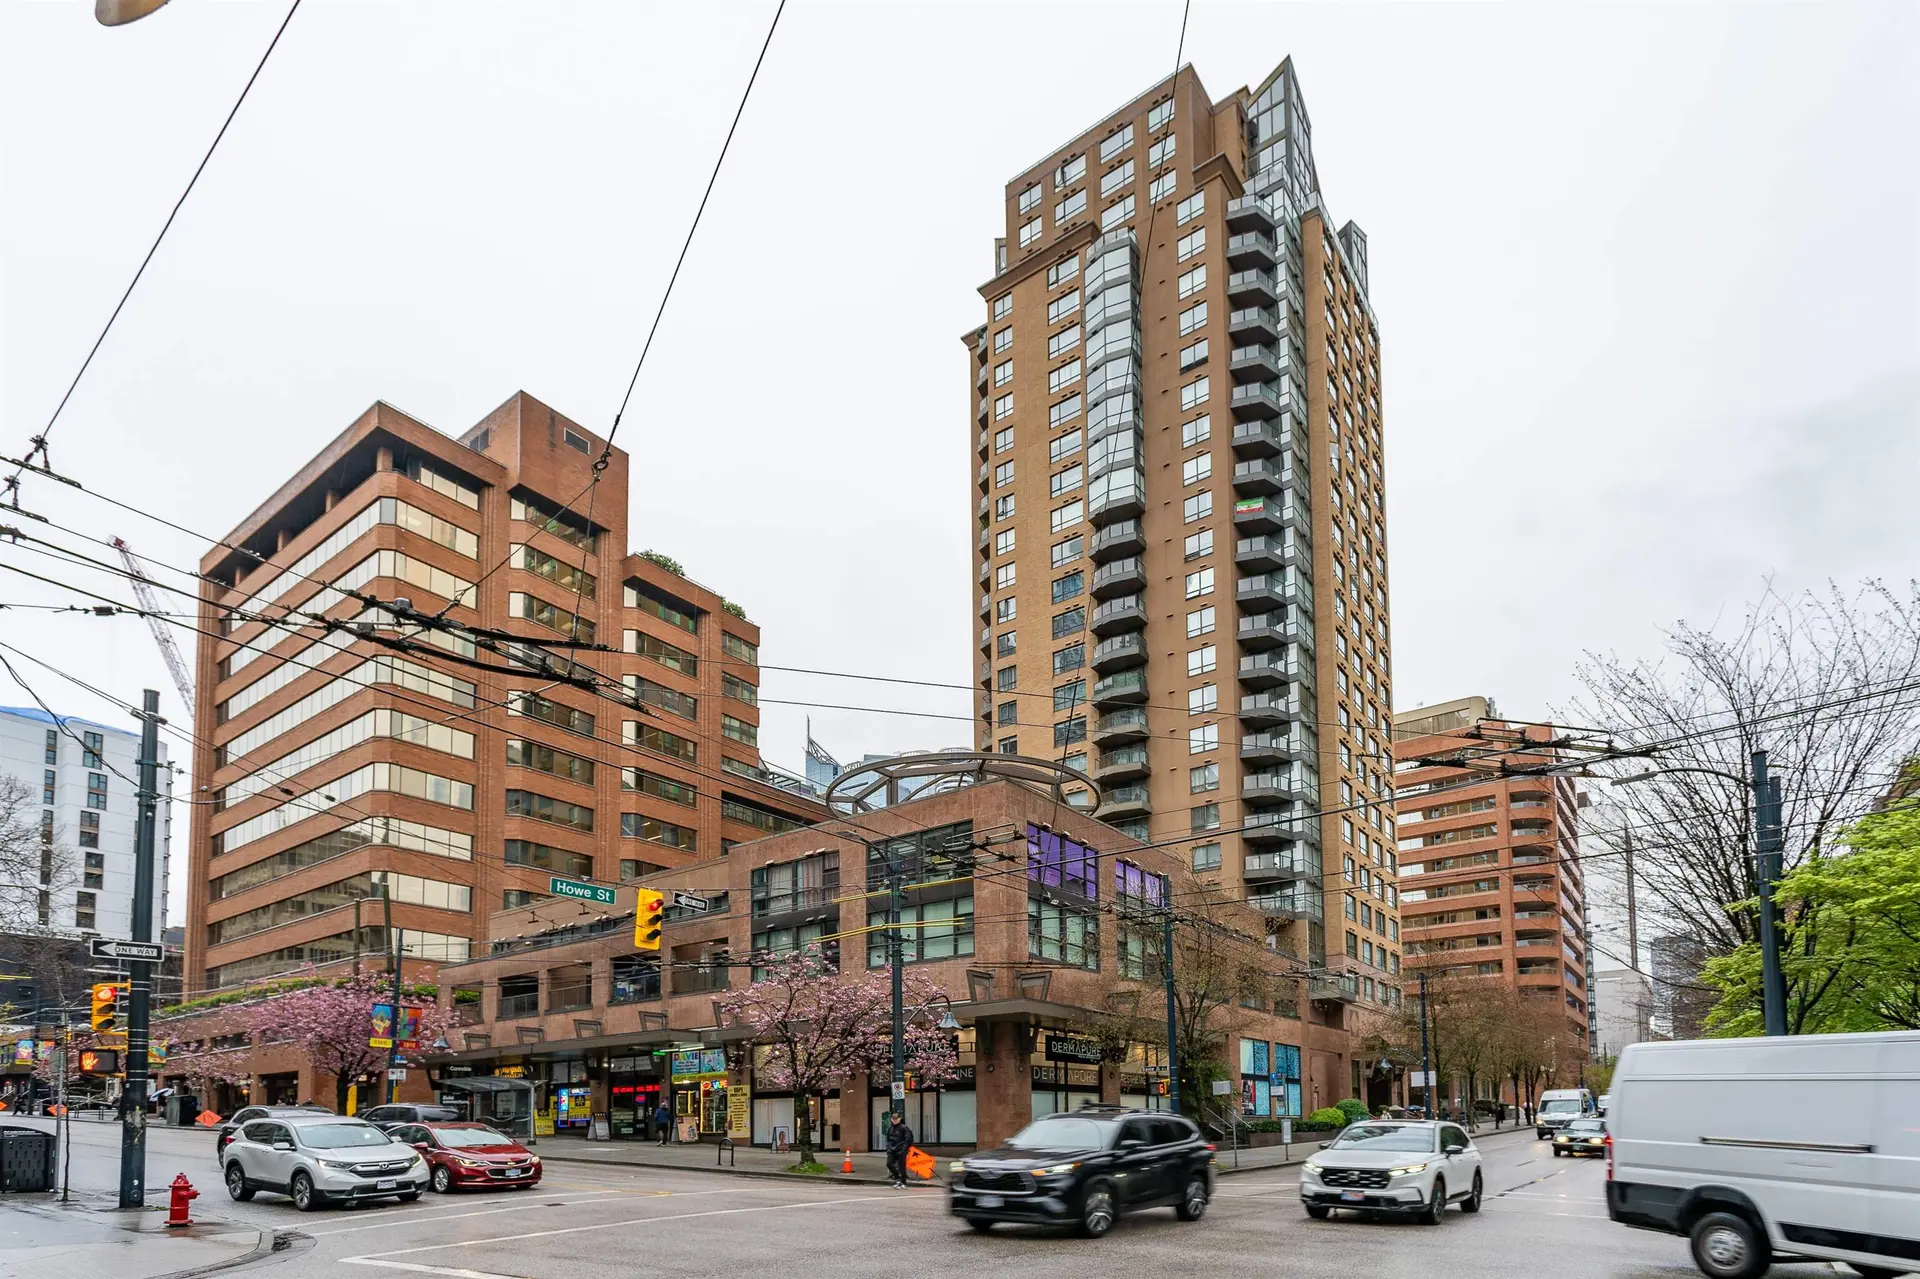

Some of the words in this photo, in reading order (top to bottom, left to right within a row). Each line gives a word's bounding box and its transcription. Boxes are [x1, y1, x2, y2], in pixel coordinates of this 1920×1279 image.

[556, 880, 592, 898] Howe
[596, 889, 610, 902] St
[114, 946, 133, 954] ONE
[136, 948, 156, 956] WAY
[673, 1050, 700, 1061] DAVIE
[1051, 1041, 1101, 1056] DERMAPURE
[1033, 1066, 1098, 1083] DERMAPURE
